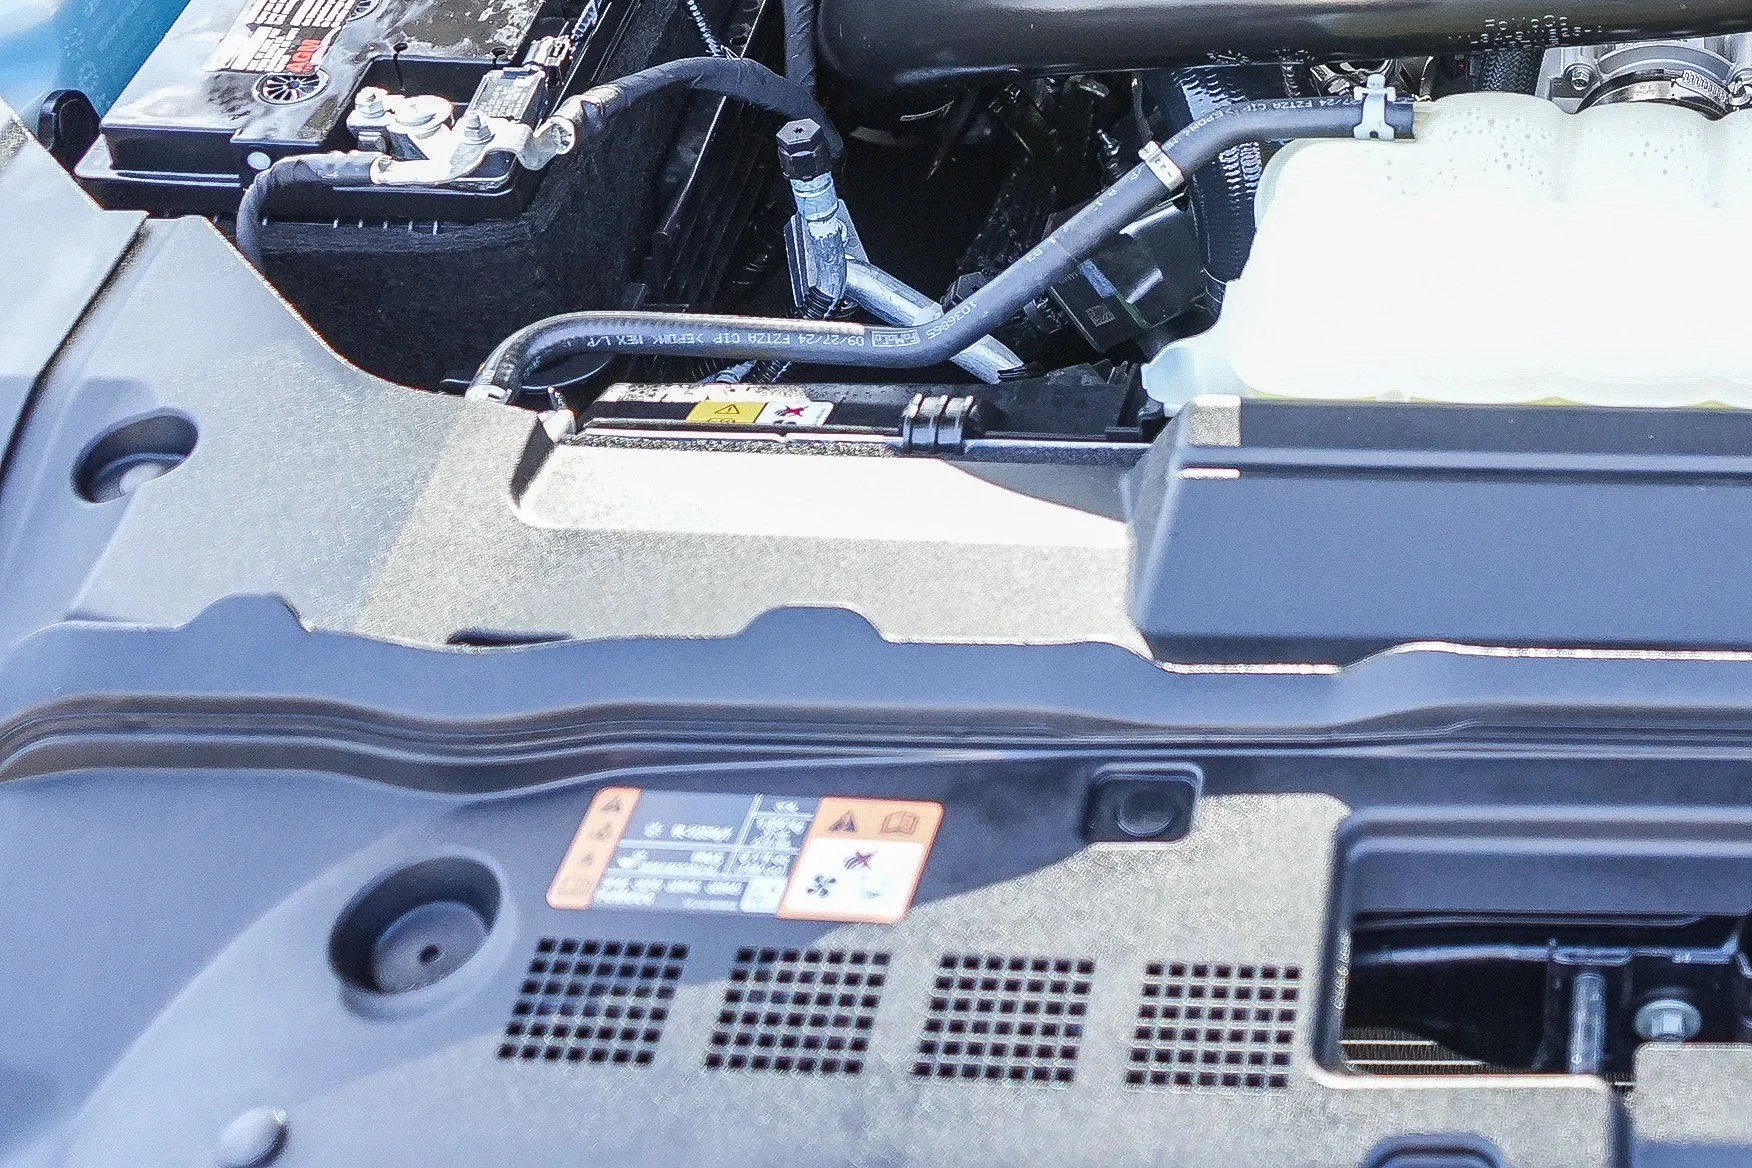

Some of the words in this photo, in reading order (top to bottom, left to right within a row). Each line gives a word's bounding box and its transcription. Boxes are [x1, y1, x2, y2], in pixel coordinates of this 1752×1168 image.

[285, 38, 322, 73] AGM
[1161, 137, 1179, 152] ME
[713, 332, 740, 345] CIP
[748, 332, 791, 345] FZTZA
[798, 333, 866, 347] 09/27/24
[872, 331, 920, 346] FoMoCo
